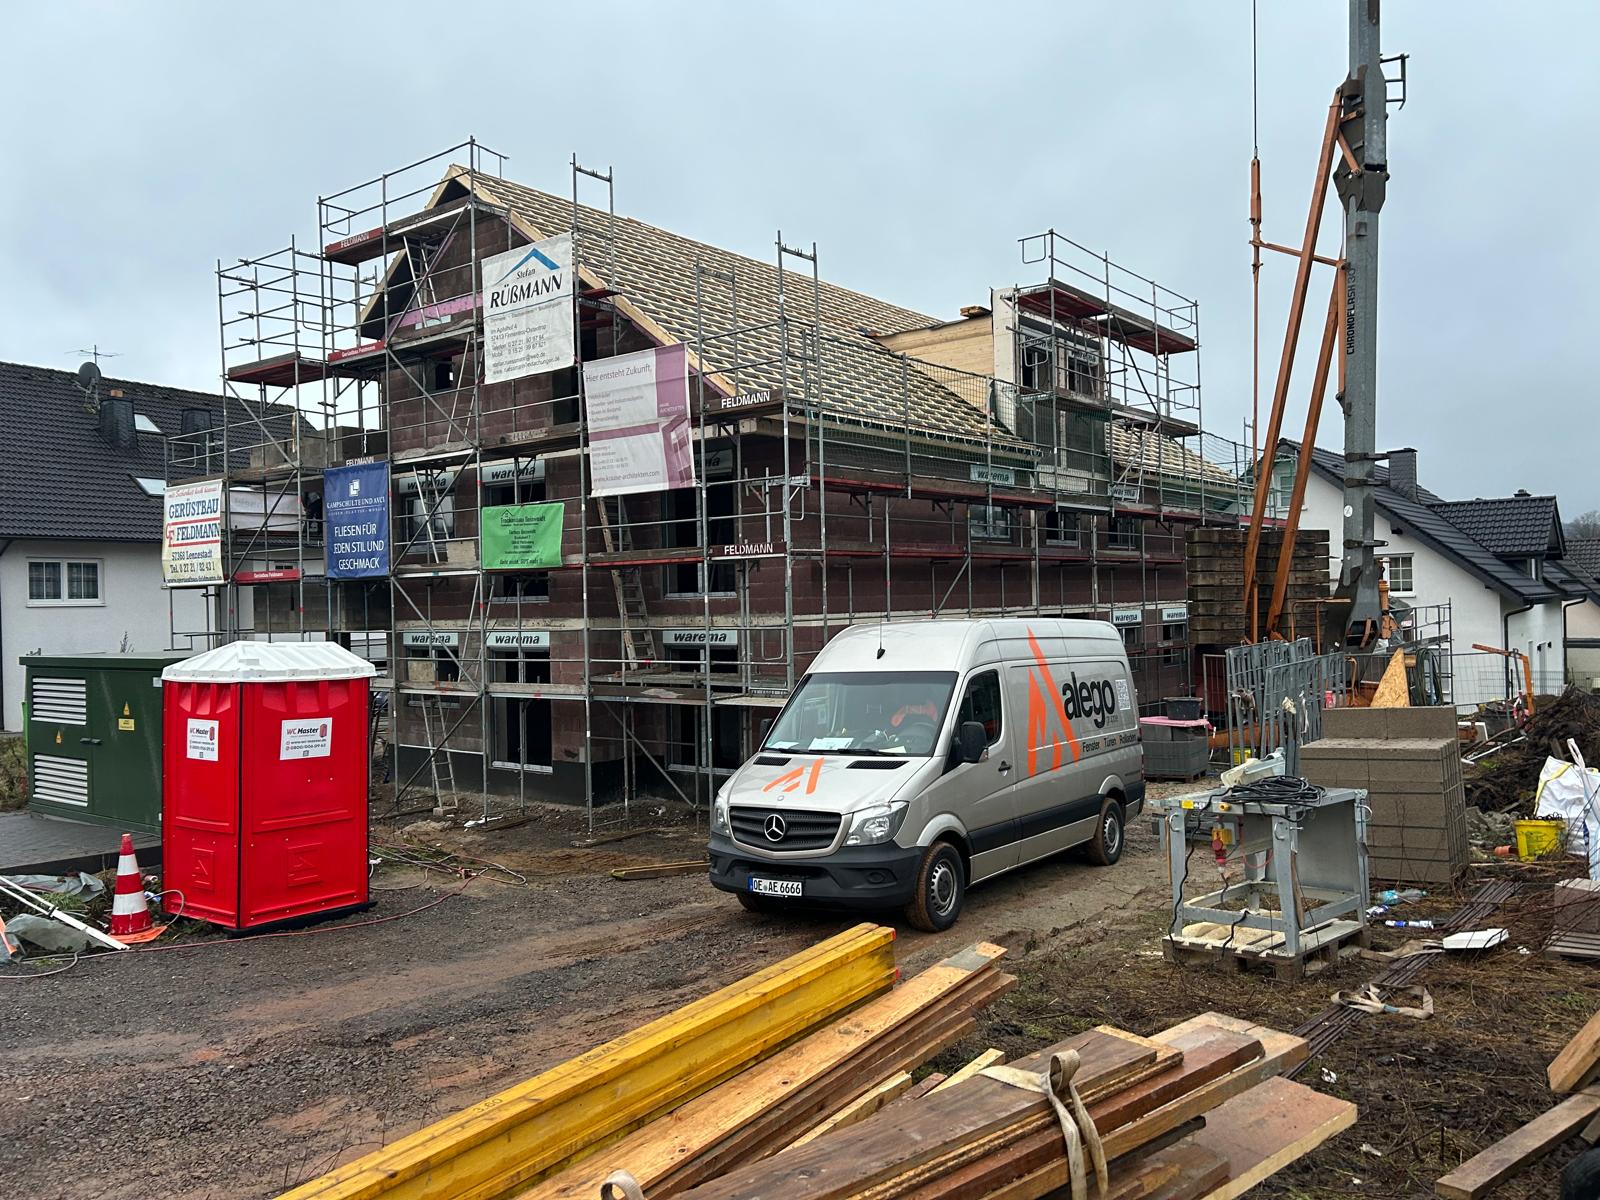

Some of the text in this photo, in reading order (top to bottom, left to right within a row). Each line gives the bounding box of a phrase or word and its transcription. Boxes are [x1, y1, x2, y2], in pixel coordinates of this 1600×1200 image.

[340, 233, 369, 248] FELDMANN
[516, 268, 536, 280] Stefan
[490, 273, 563, 309] RÜßMANN
[1346, 285, 1356, 355] CHRONOFLASH
[586, 374, 599, 382] Hier
[600, 369, 625, 380] entsteht
[721, 391, 771, 409] FELDMANN
[346, 456, 375, 466] FELDMANN
[168, 498, 219, 518] GERÜSTBAU
[176, 523, 221, 541] FELDMANN
[334, 521, 377, 537] FLIESEN FÜR
[351, 541, 367, 553] STIL
[367, 540, 384, 551] UND
[724, 543, 773, 555] FELDMANN
[172, 549, 212, 561] 57368 Lennestadt
[170, 564, 179, 573] Tel.
[338, 557, 380, 570] GESCHMACK
[1115, 613, 1138, 621] warema
[1166, 611, 1186, 619] warema
[1062, 671, 1115, 729] alego
[297, 727, 319, 735] Master
[1082, 741, 1100, 752] Fenster
[753, 879, 801, 895] OE AE 6666
